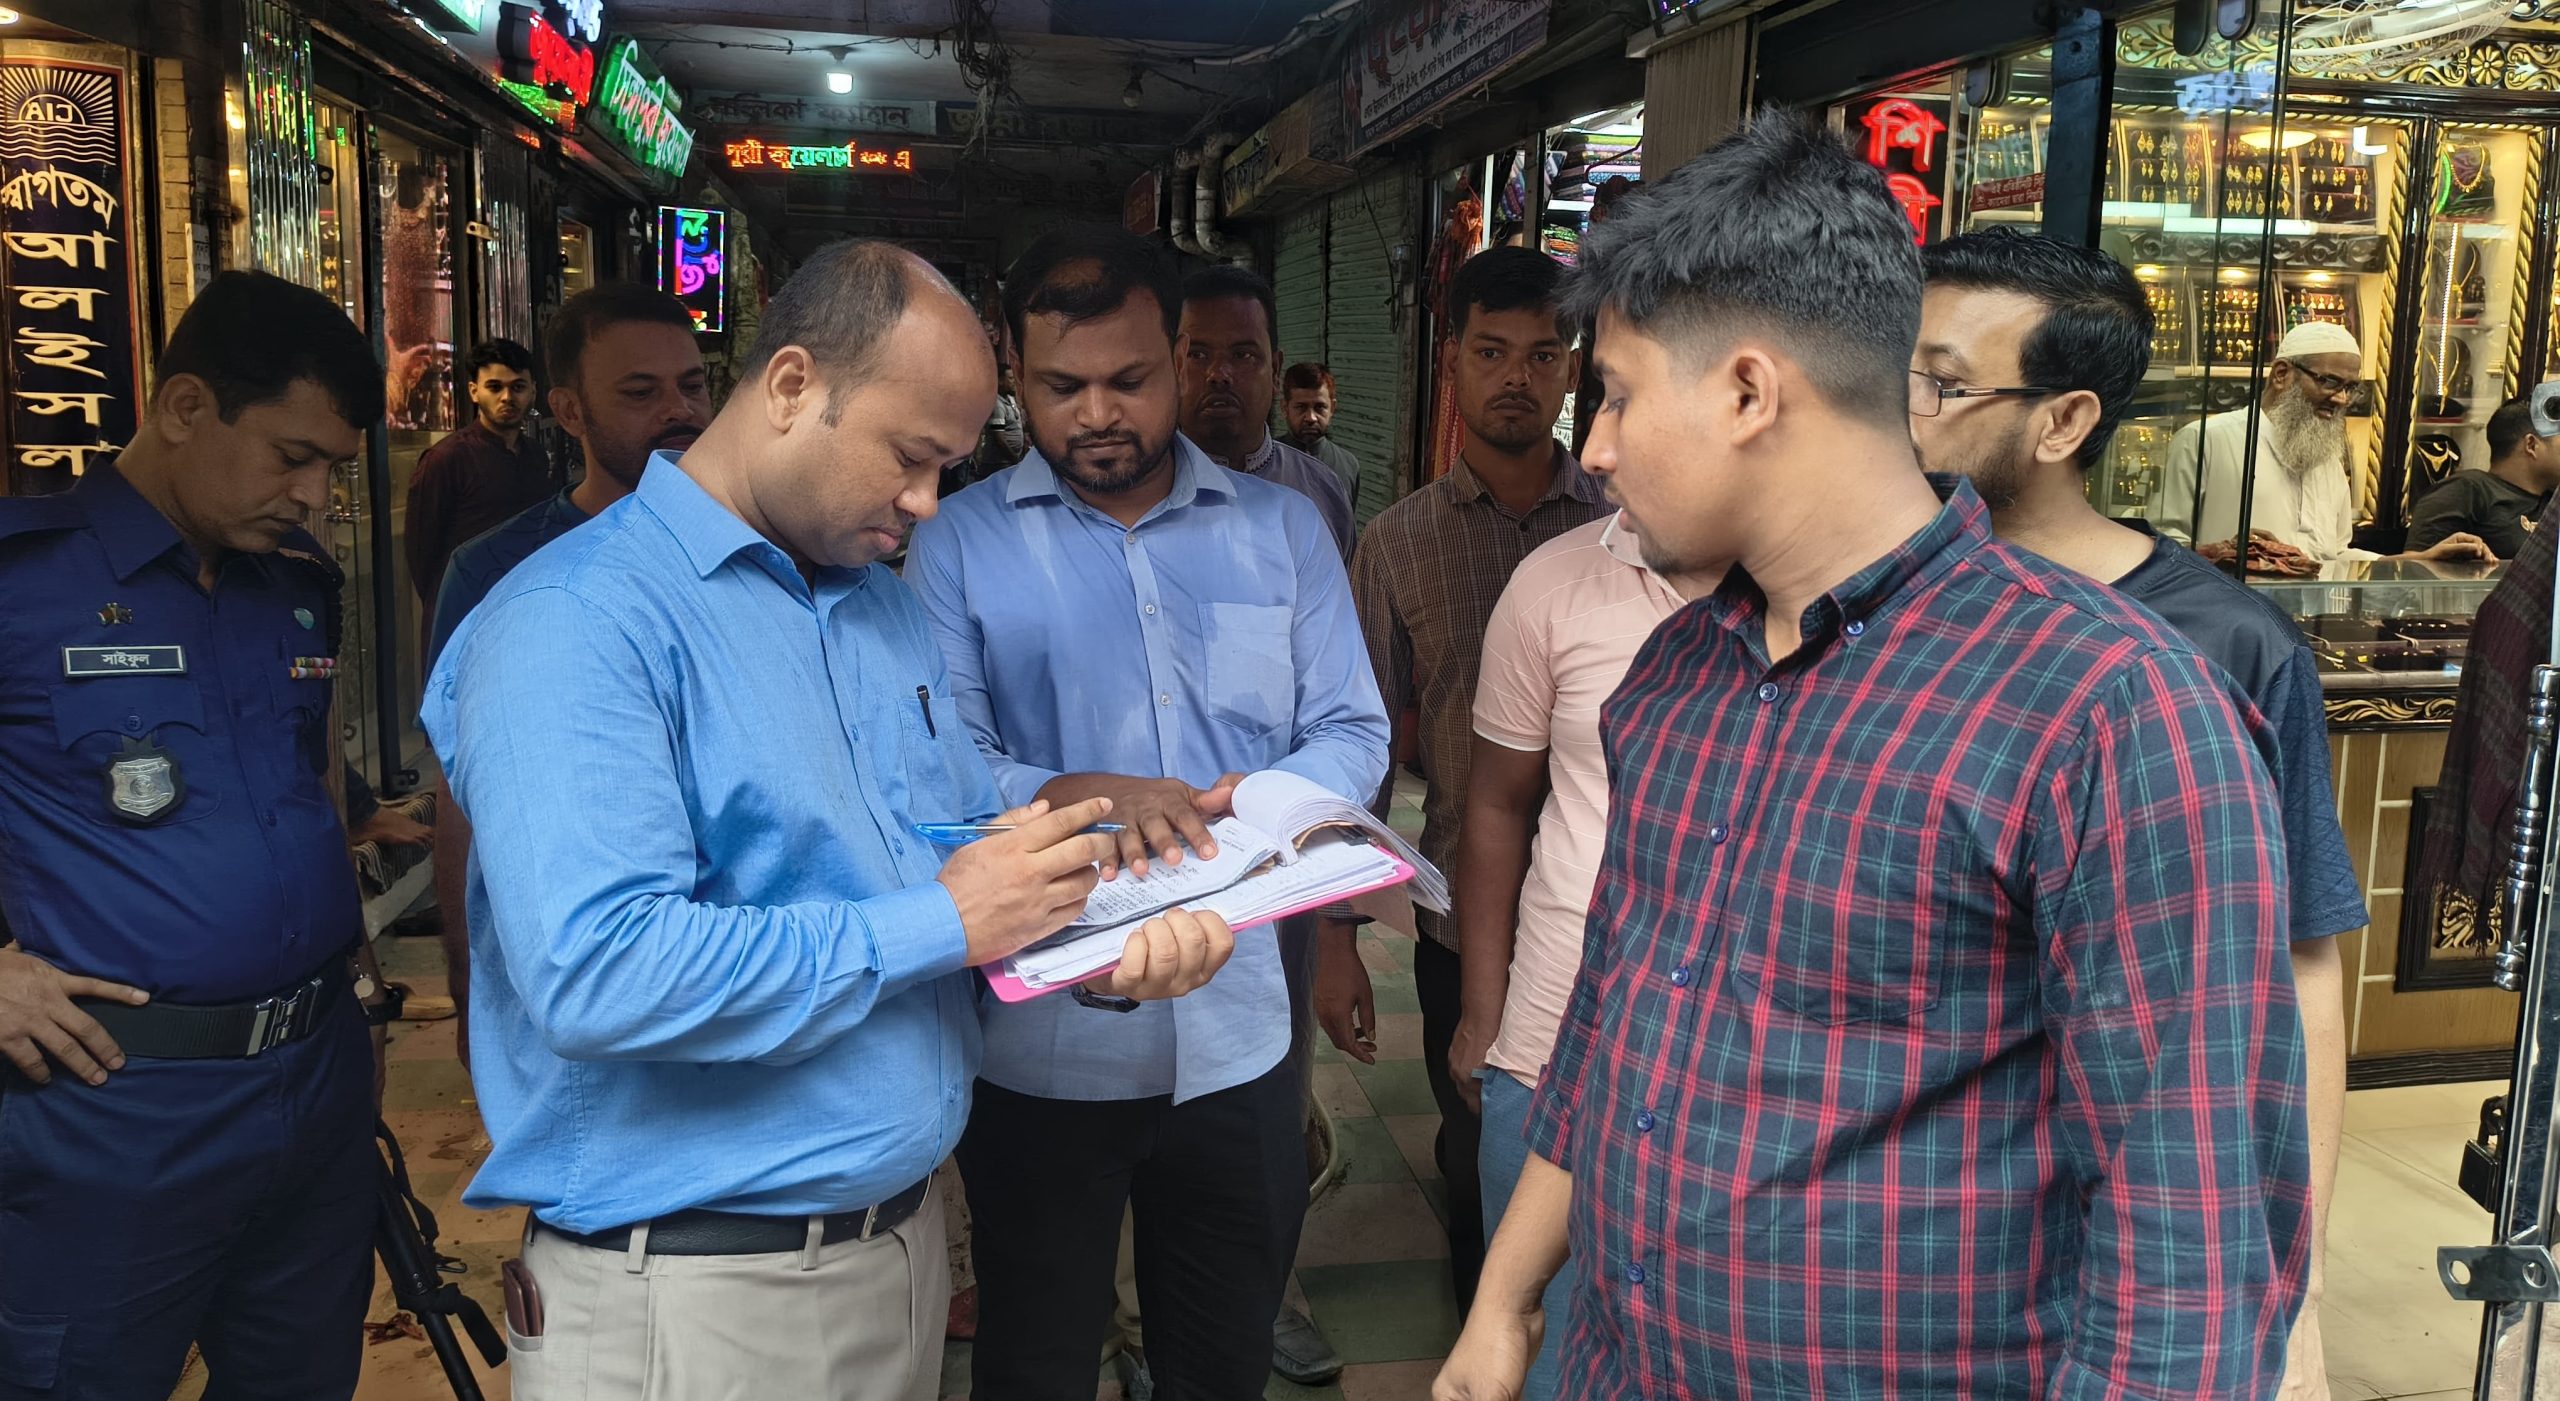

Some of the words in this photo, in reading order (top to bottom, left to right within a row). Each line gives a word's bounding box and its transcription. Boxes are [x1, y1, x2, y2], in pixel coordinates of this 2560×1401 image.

[655, 105, 697, 178] জুয়েলার্স
[767, 141, 856, 169] জুয়েলার্স
[0, 163, 118, 230] স্বাগতম
[102, 651, 150, 668] সাইফুল
